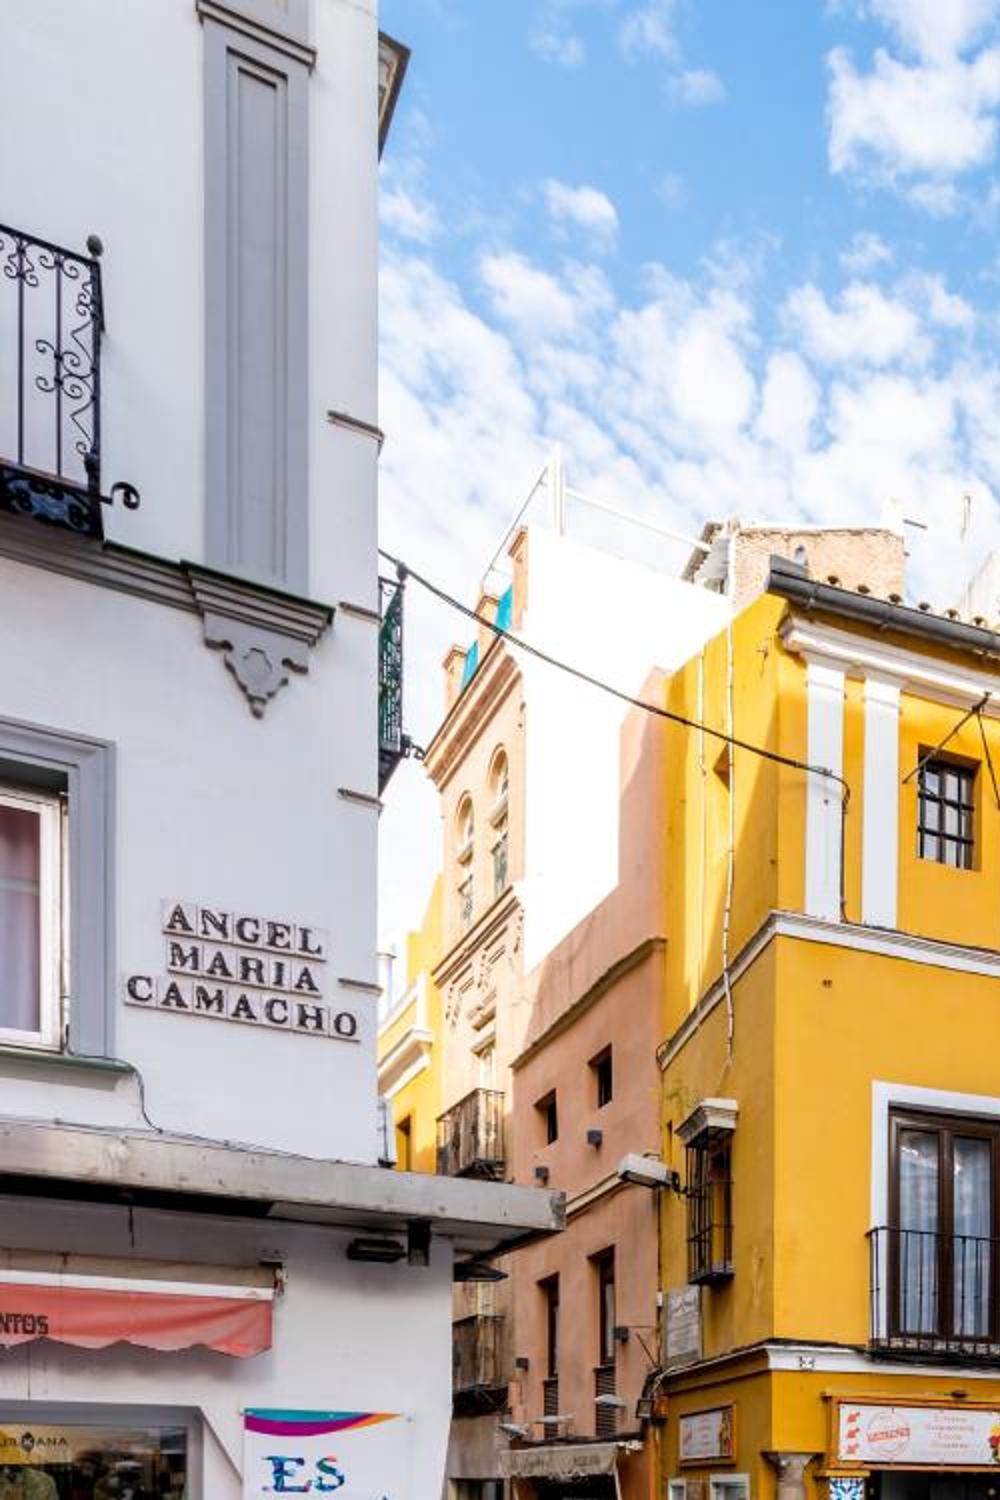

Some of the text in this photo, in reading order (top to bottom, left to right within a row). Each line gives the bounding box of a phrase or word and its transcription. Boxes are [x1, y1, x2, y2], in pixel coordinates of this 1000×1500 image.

[166, 903, 323, 955] ANGEL
[169, 941, 319, 992] MARIA
[126, 975, 358, 1037] CAMACHO
